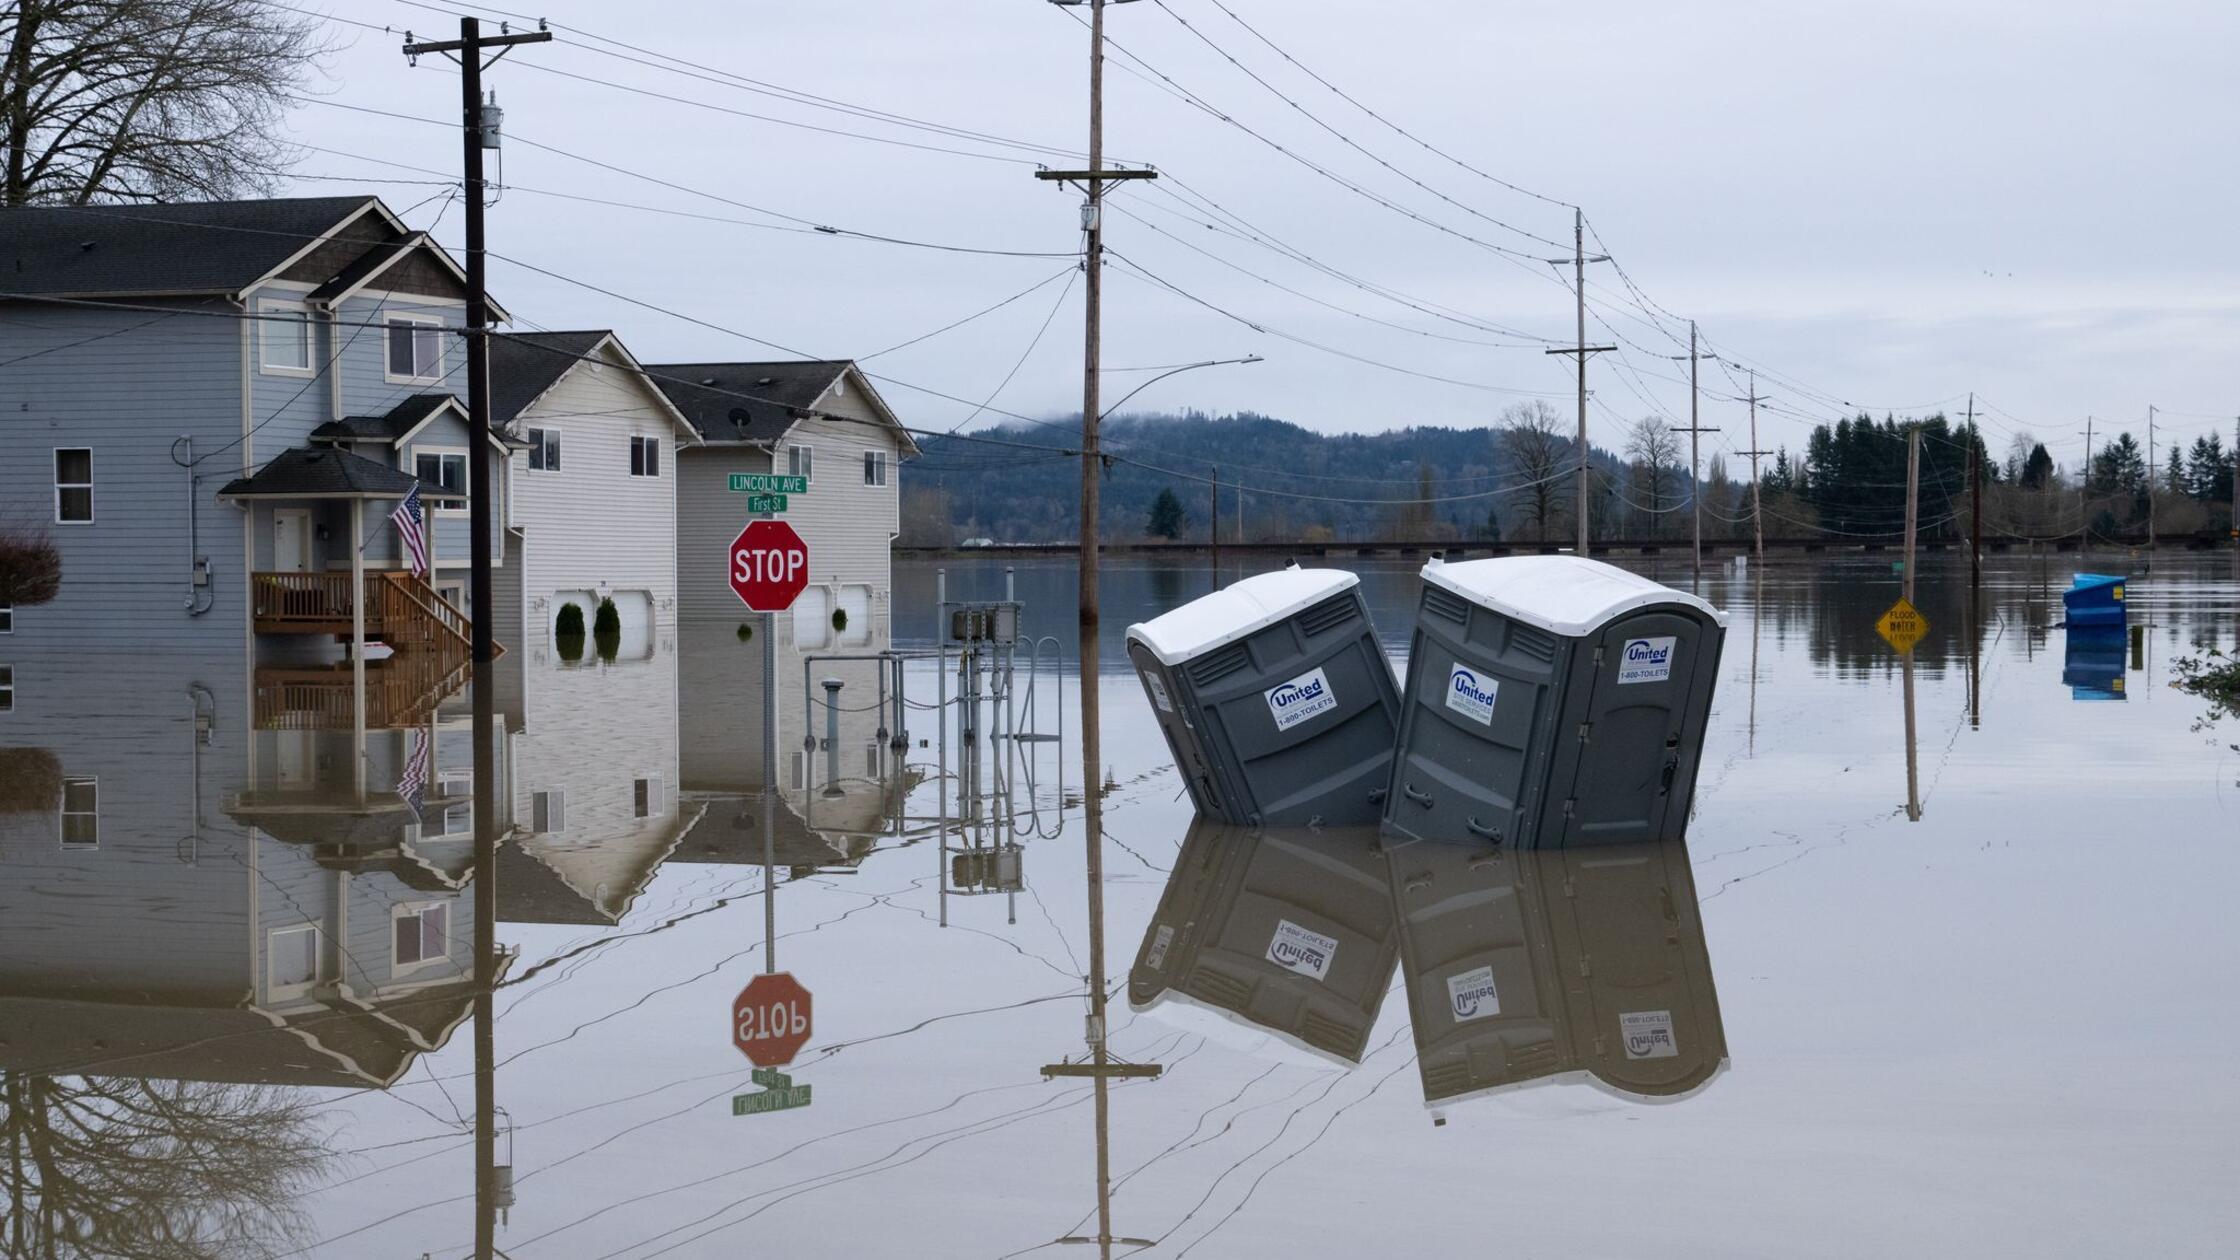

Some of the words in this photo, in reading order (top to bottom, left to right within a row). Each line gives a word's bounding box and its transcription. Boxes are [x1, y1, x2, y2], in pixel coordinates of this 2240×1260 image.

[734, 475, 778, 491] LINCOLN
[782, 477, 802, 492] AVE
[753, 497, 771, 511] First
[772, 496, 782, 511] St
[735, 548, 804, 583] STOP
[1890, 611, 1916, 620] FLOOD
[1629, 645, 1669, 661] United
[1275, 678, 1322, 707] United
[1455, 676, 1495, 707] United
[1279, 697, 1333, 726] 1-800-TOILETS
